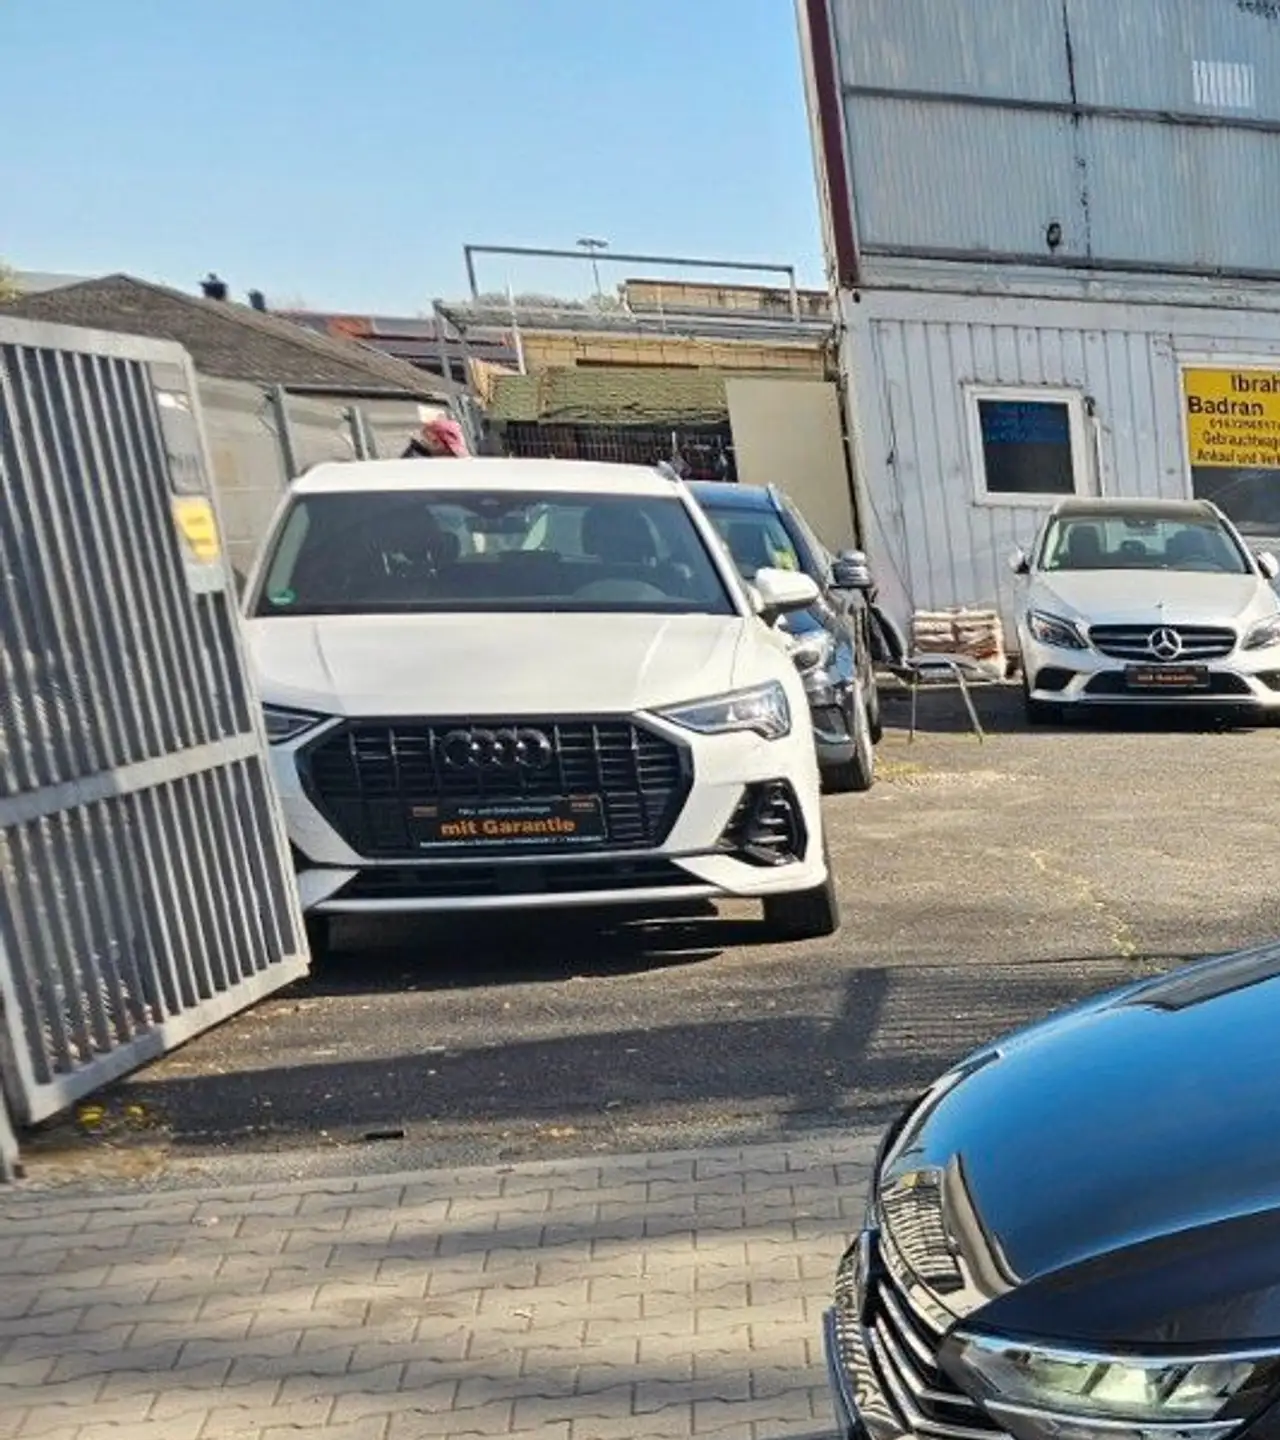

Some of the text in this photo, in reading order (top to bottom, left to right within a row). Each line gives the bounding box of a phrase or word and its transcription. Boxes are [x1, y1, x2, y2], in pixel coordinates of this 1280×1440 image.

[1187, 396, 1264, 417] Badran
[1196, 448, 1235, 462] Ankauf
[1236, 450, 1257, 464] und
[439, 815, 577, 837] mit Garantie
